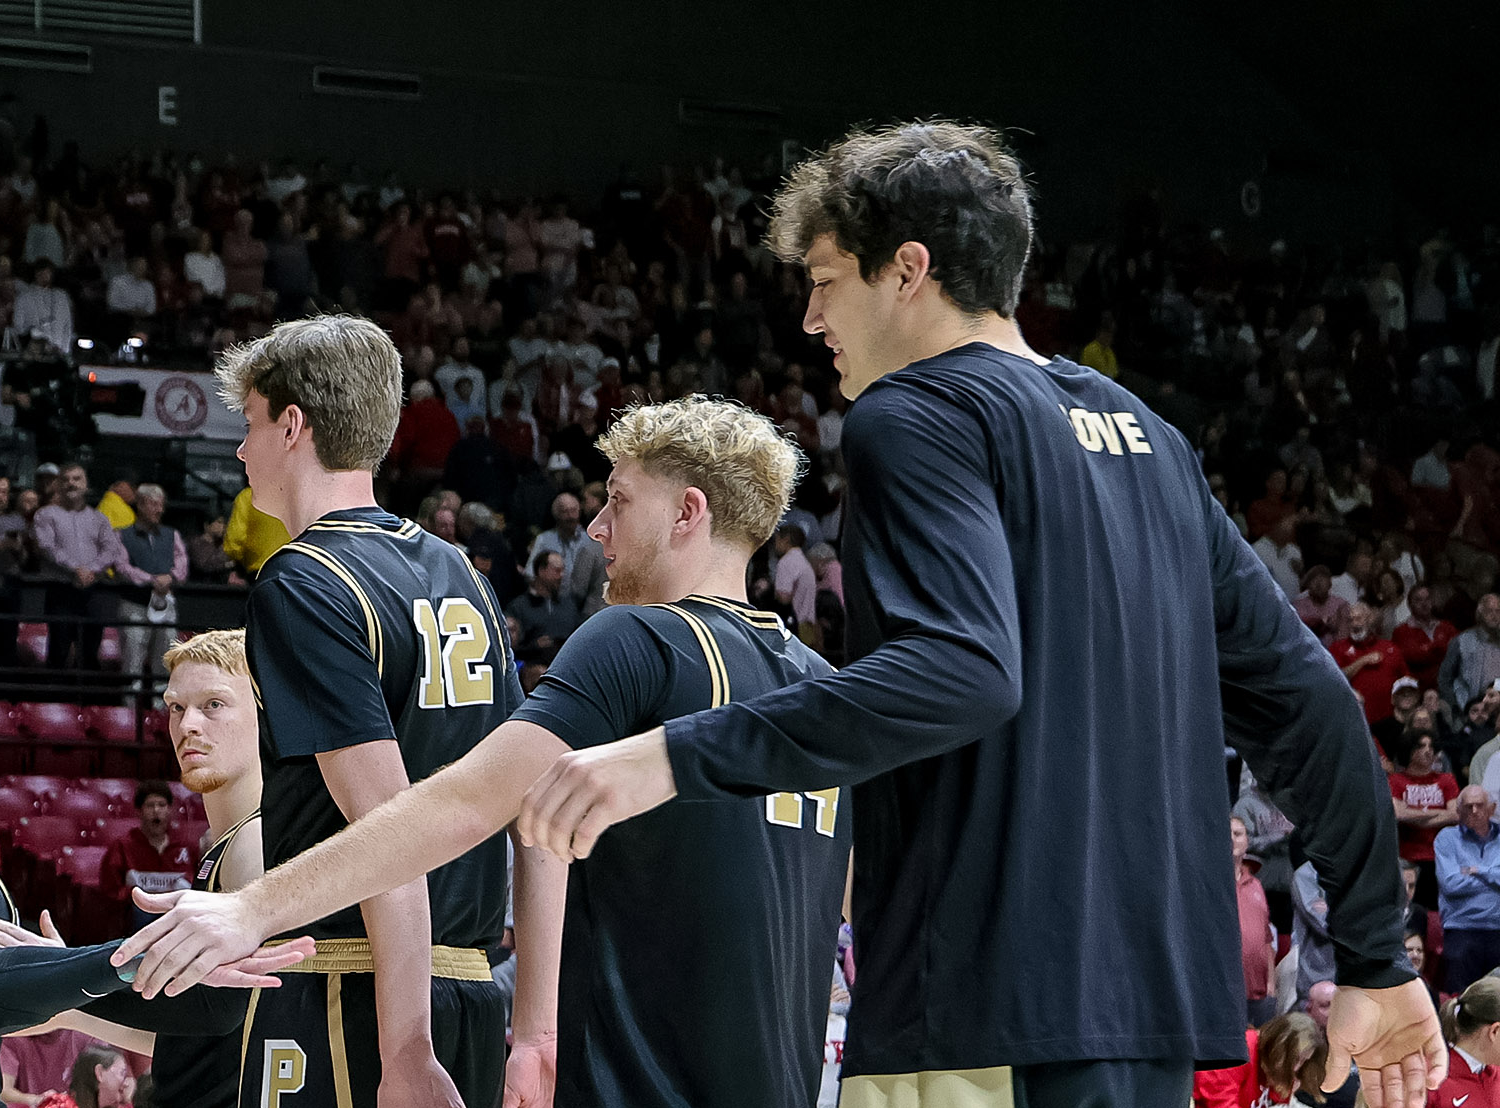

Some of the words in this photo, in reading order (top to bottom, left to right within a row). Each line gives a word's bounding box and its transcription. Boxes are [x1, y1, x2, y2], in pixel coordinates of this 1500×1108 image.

[159, 87, 177, 125] E
[1058, 403, 1153, 456] OVE
[413, 597, 494, 710] 12
